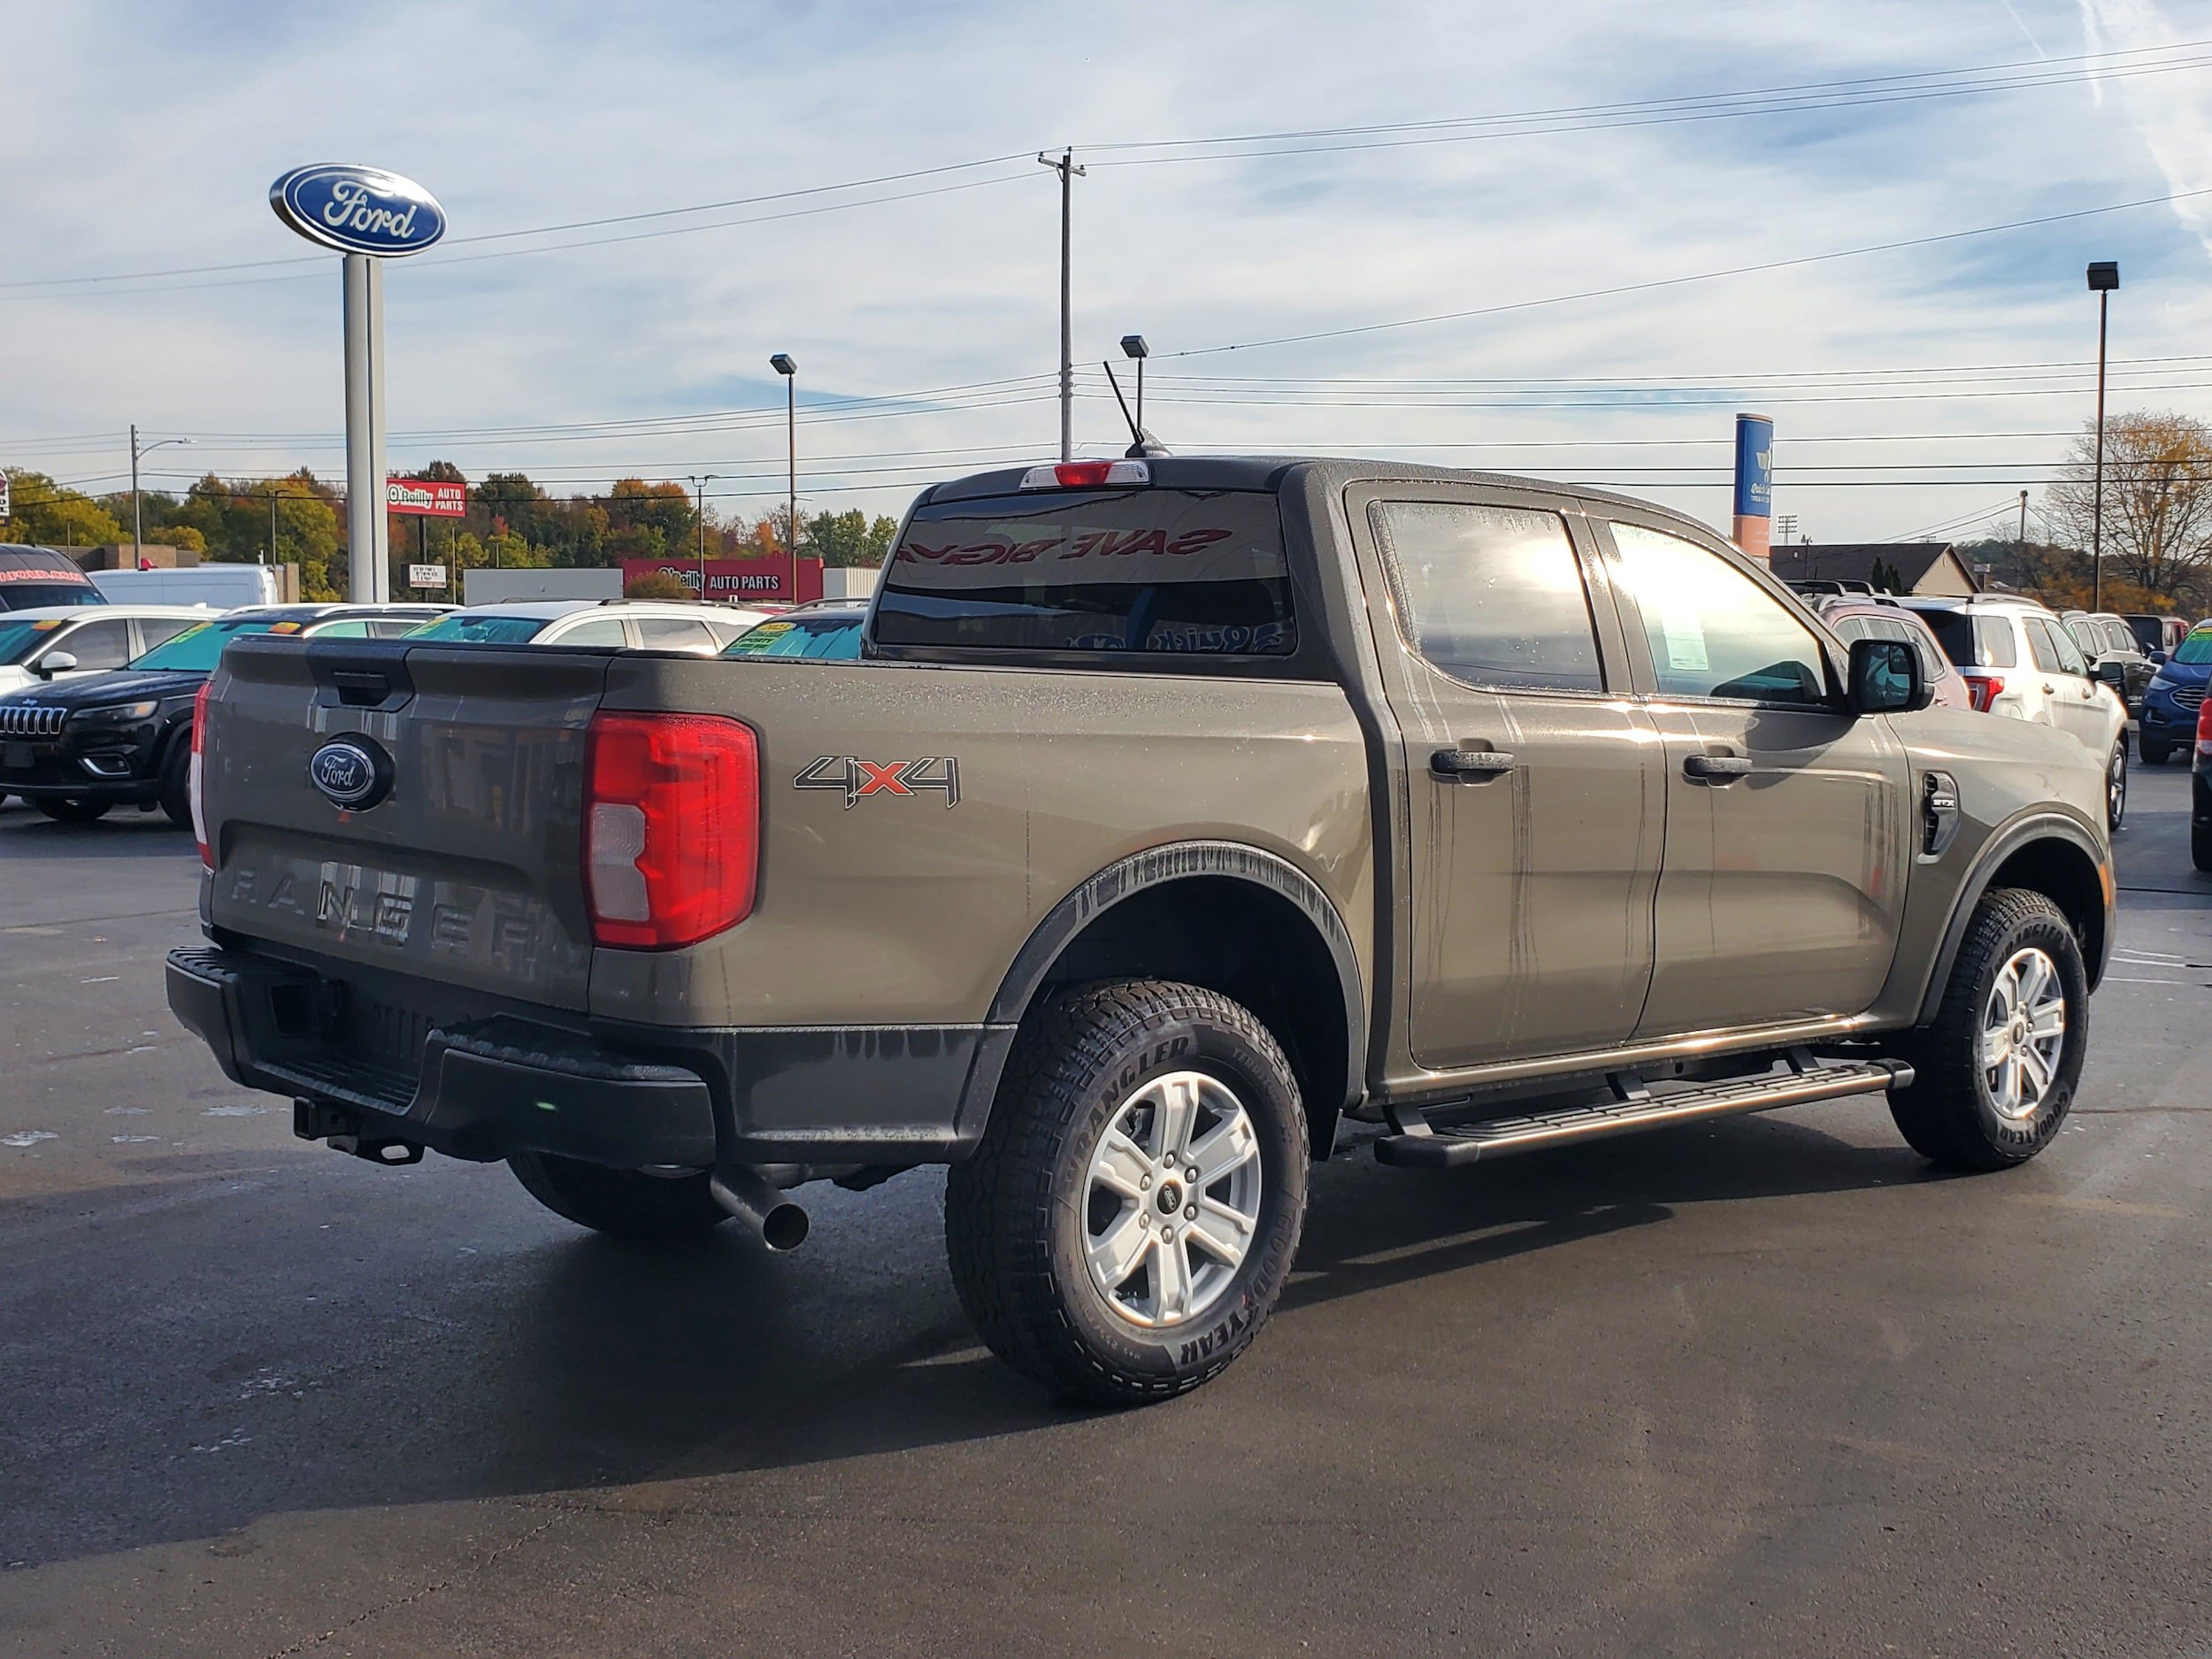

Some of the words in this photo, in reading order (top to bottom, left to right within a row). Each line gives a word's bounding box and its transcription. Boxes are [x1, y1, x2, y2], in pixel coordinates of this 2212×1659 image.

[324, 180, 416, 238] Ford
[388, 484, 434, 510] O'Reilly
[435, 500, 464, 511] PARTS
[437, 488, 461, 500] AUTO
[710, 576, 738, 589] AUTO
[741, 576, 779, 589] PARTS
[321, 755, 356, 787] Ford
[231, 865, 536, 979] RANGER
[1994, 923, 2065, 967] WRANGLER
[1064, 1035, 1189, 1184] WRANGLER
